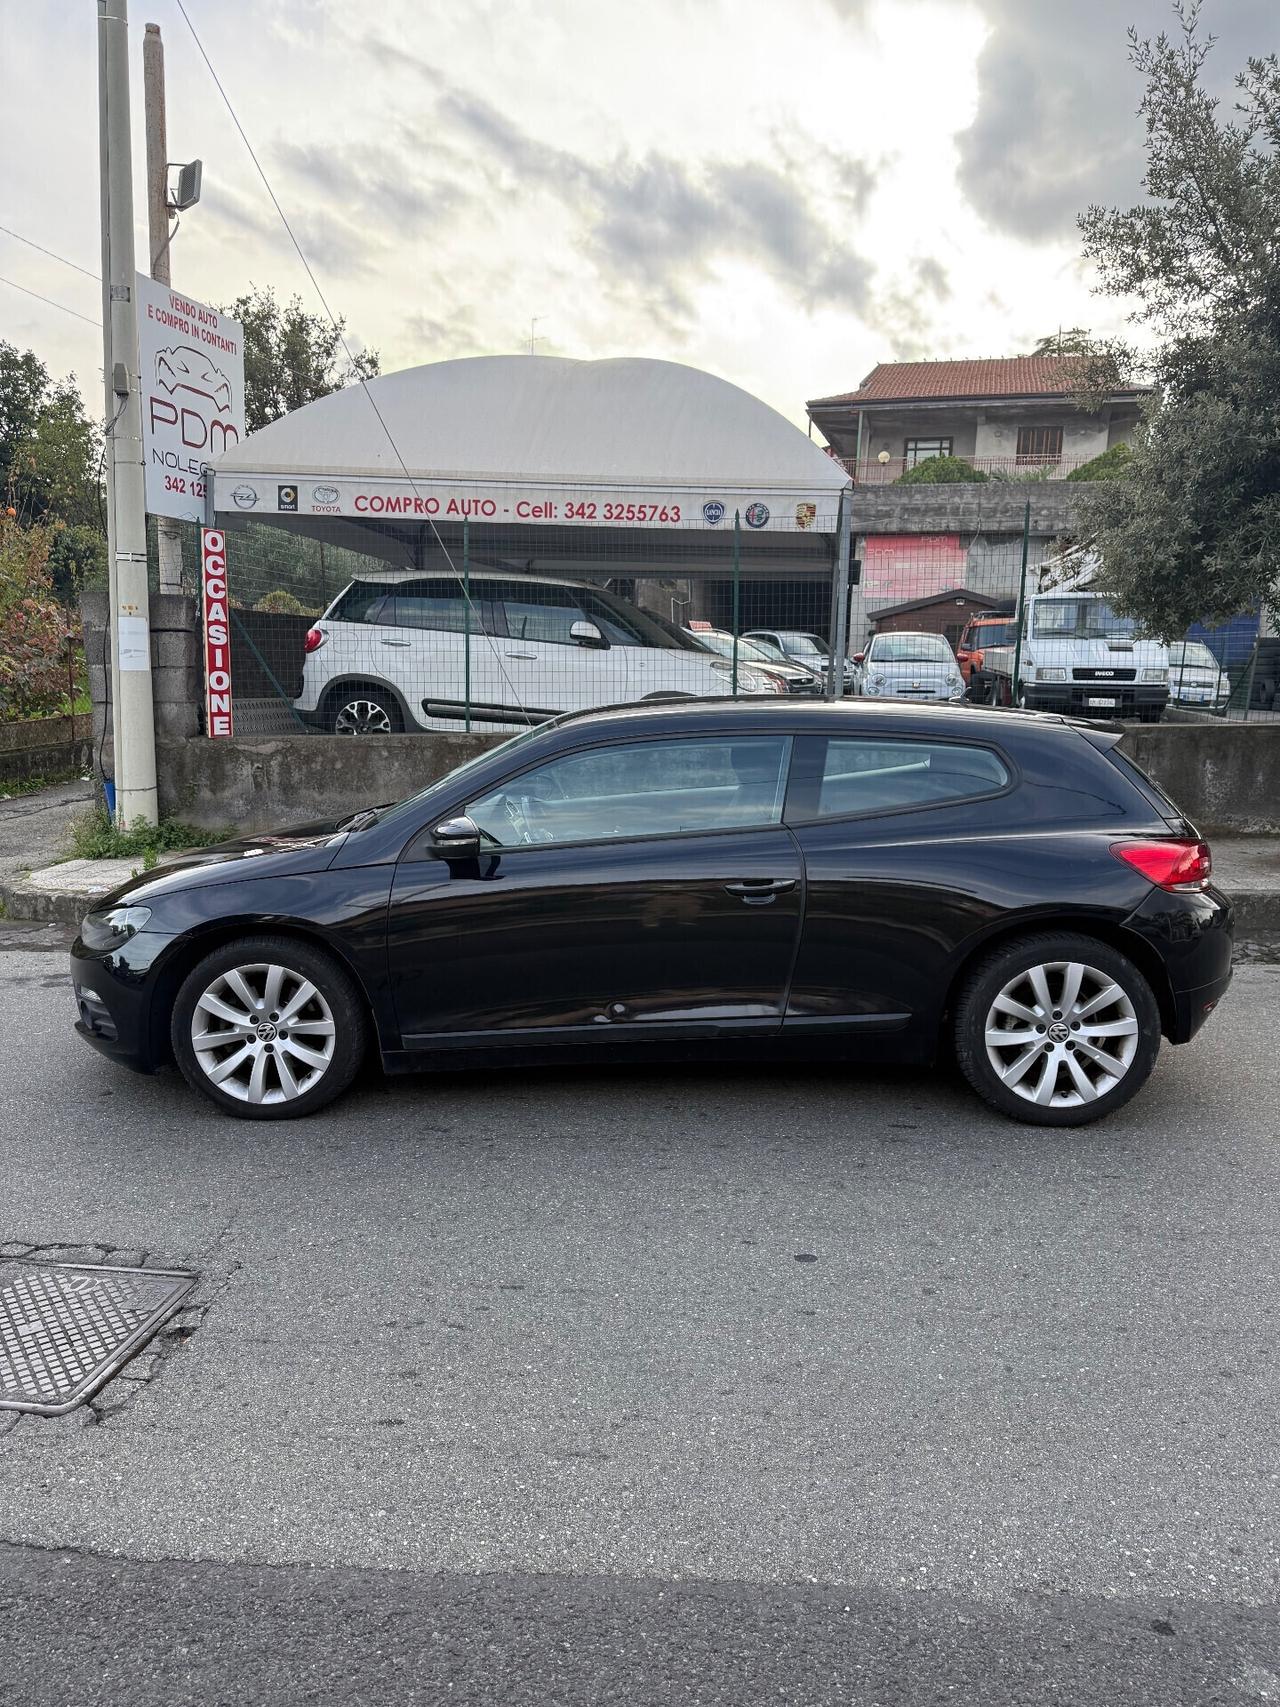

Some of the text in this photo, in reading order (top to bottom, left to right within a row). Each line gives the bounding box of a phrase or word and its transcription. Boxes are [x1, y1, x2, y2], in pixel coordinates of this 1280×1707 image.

[169, 293, 218, 328] VENDO AUTO
[148, 303, 237, 356] E COMPRO IN CONTANTI
[165, 475, 186, 494] 342
[311, 505, 341, 513] TOYOTA
[354, 495, 440, 515] COMPRO
[446, 497, 496, 517] AUTO
[516, 500, 558, 519] Cell:
[564, 502, 597, 520] 342
[603, 502, 681, 523] 3255763
[204, 531, 230, 736] OCCASIONE
